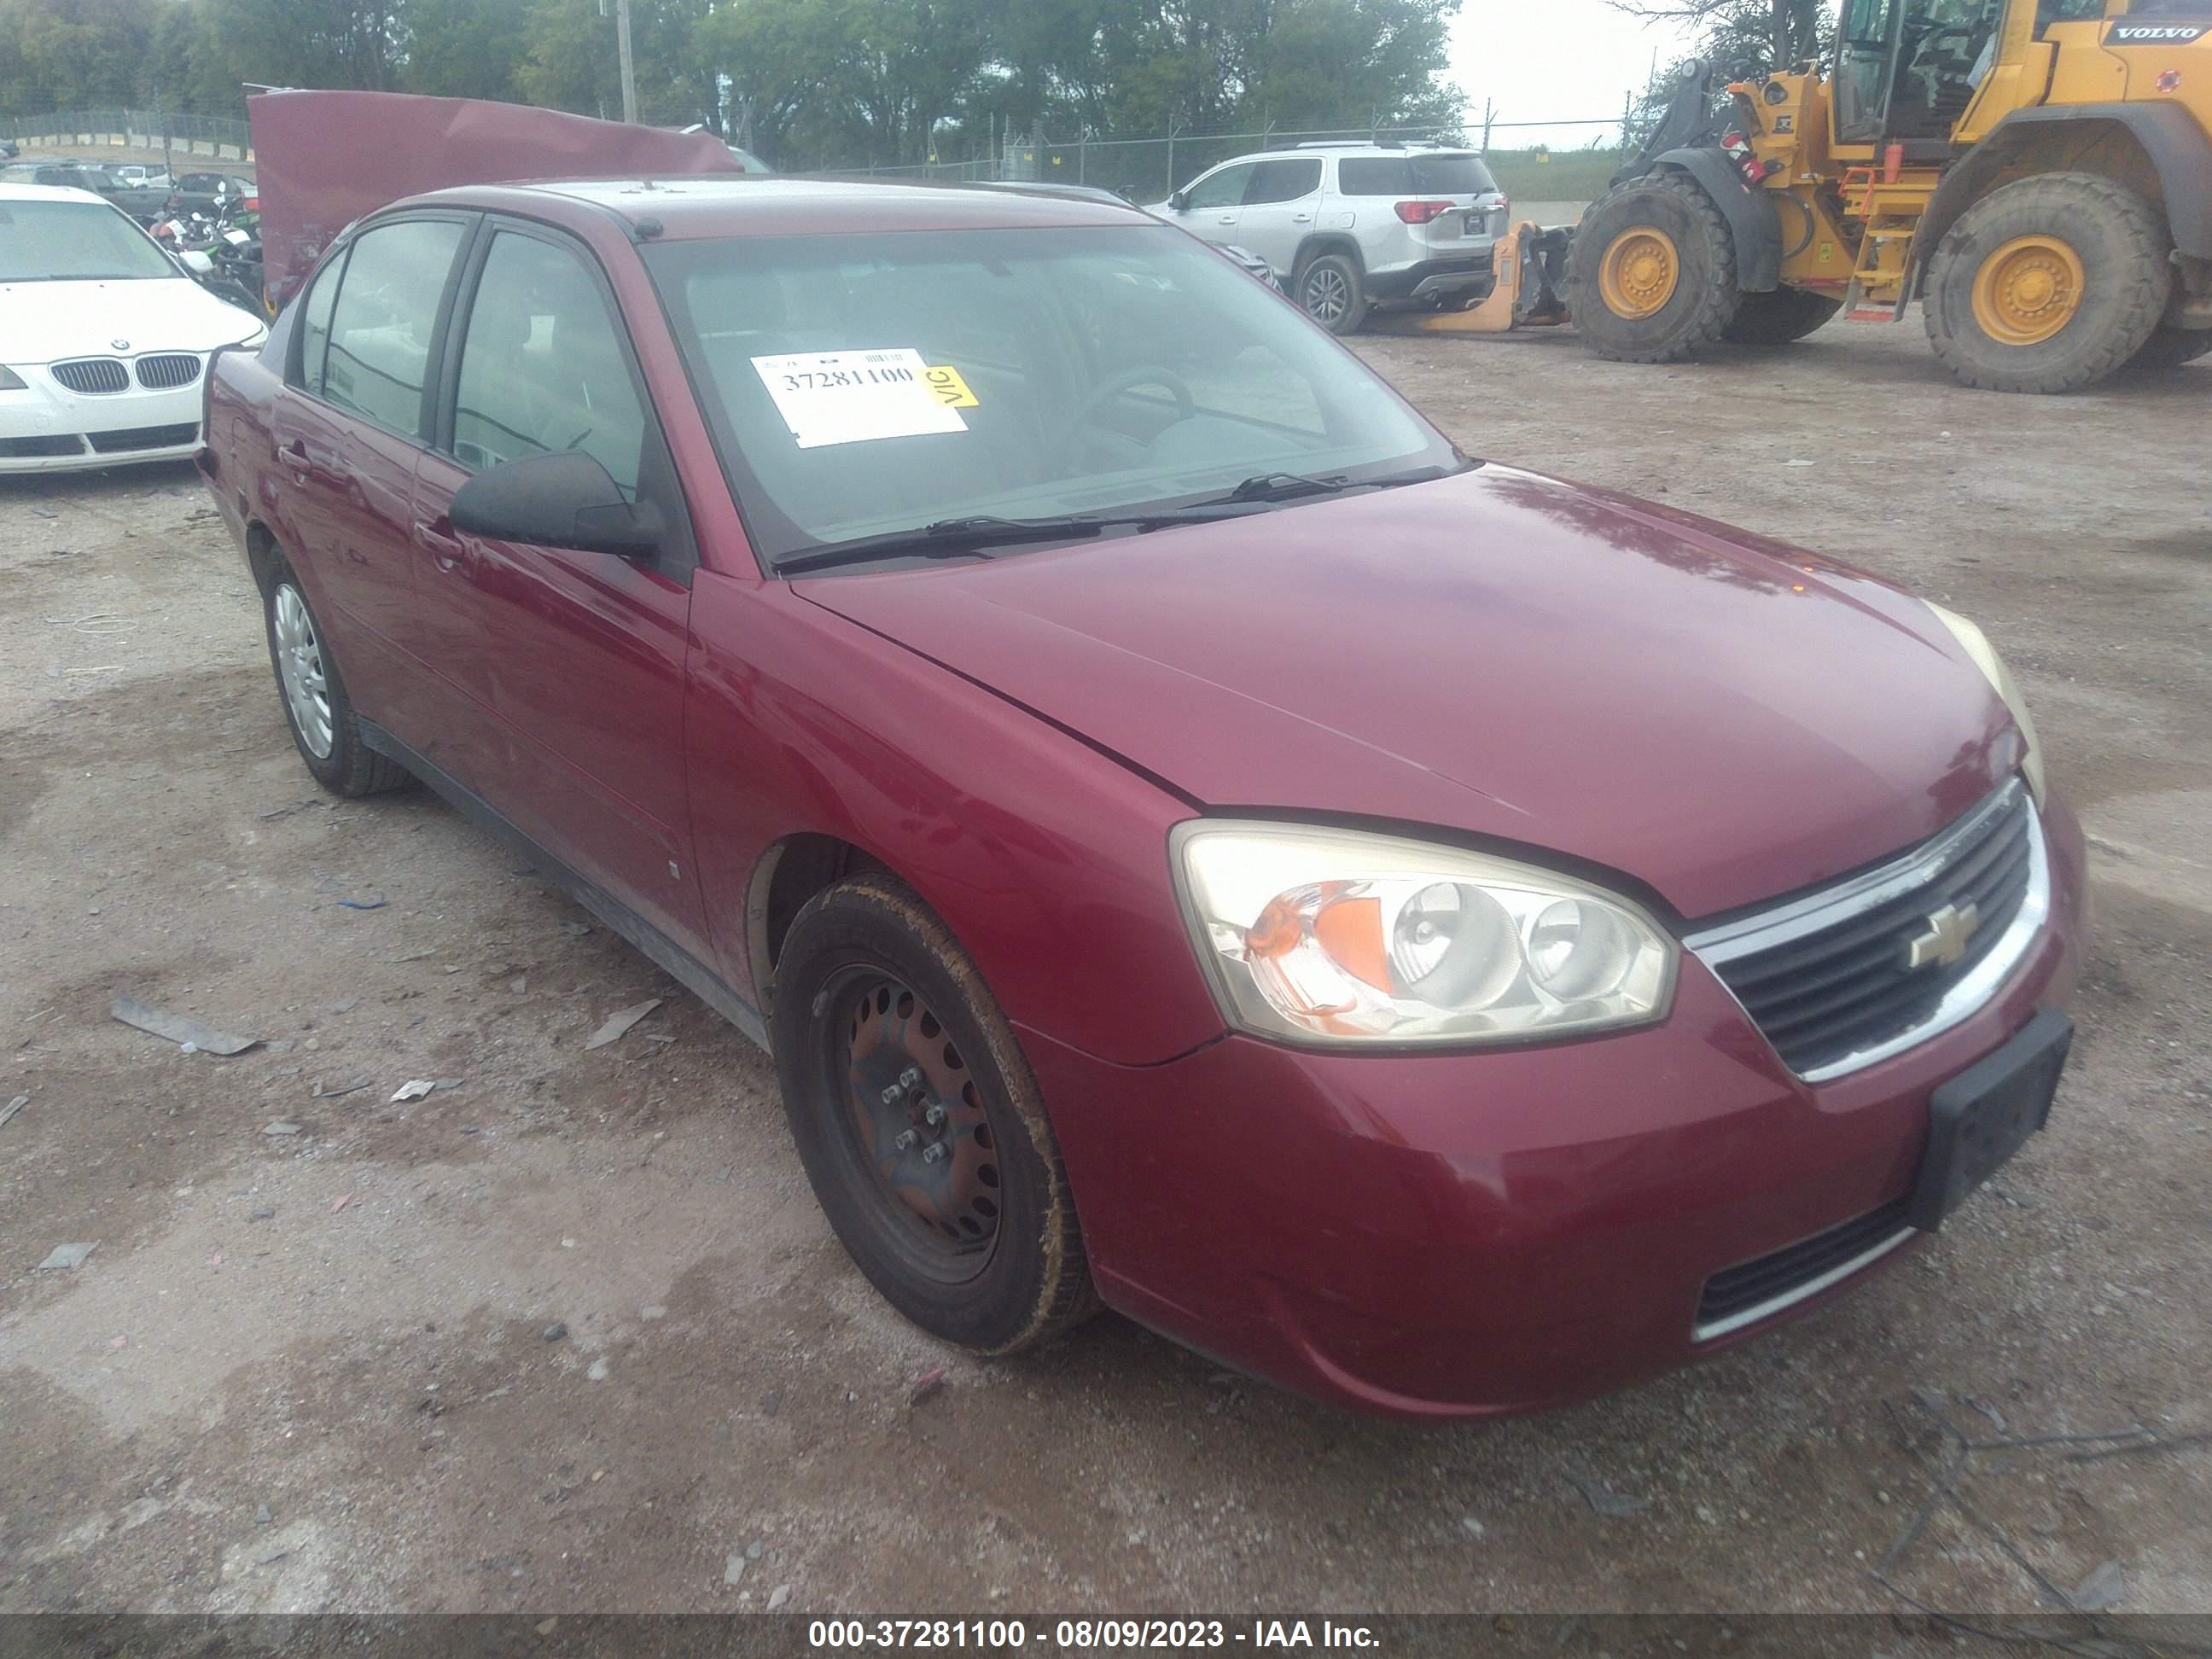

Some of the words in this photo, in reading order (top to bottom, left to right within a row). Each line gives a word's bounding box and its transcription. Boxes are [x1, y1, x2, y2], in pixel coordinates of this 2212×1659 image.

[2116, 27, 2199, 39] VOLVO
[783, 368, 913, 391] 37281100
[925, 371, 963, 405] VIC
